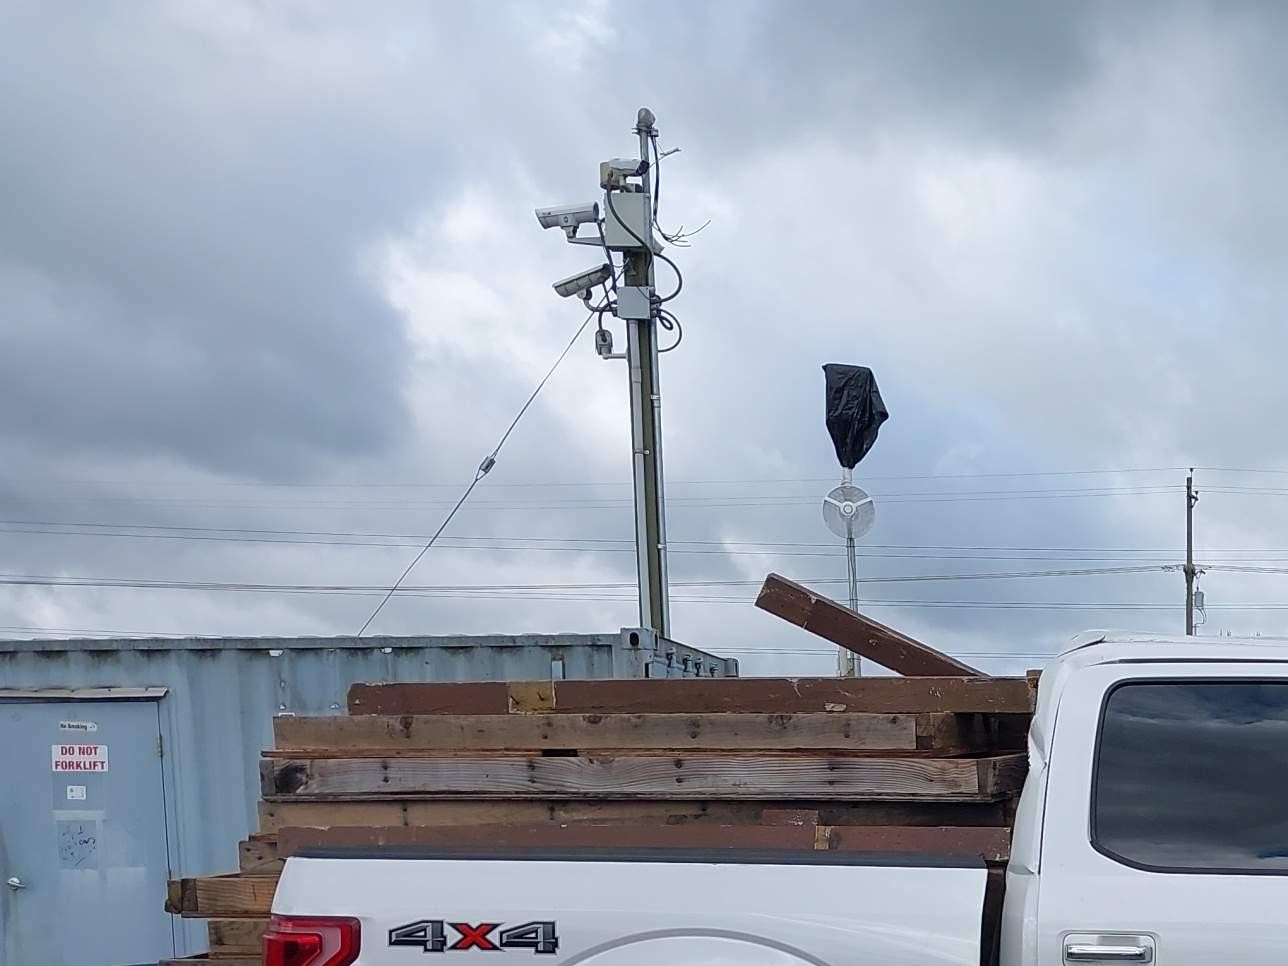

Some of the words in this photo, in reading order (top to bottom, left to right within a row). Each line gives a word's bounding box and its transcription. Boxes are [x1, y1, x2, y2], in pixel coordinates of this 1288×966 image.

[68, 723, 88, 731] Smoking
[60, 746, 76, 756] DO
[78, 746, 99, 756] NOT
[54, 760, 107, 771] FORKLIFT
